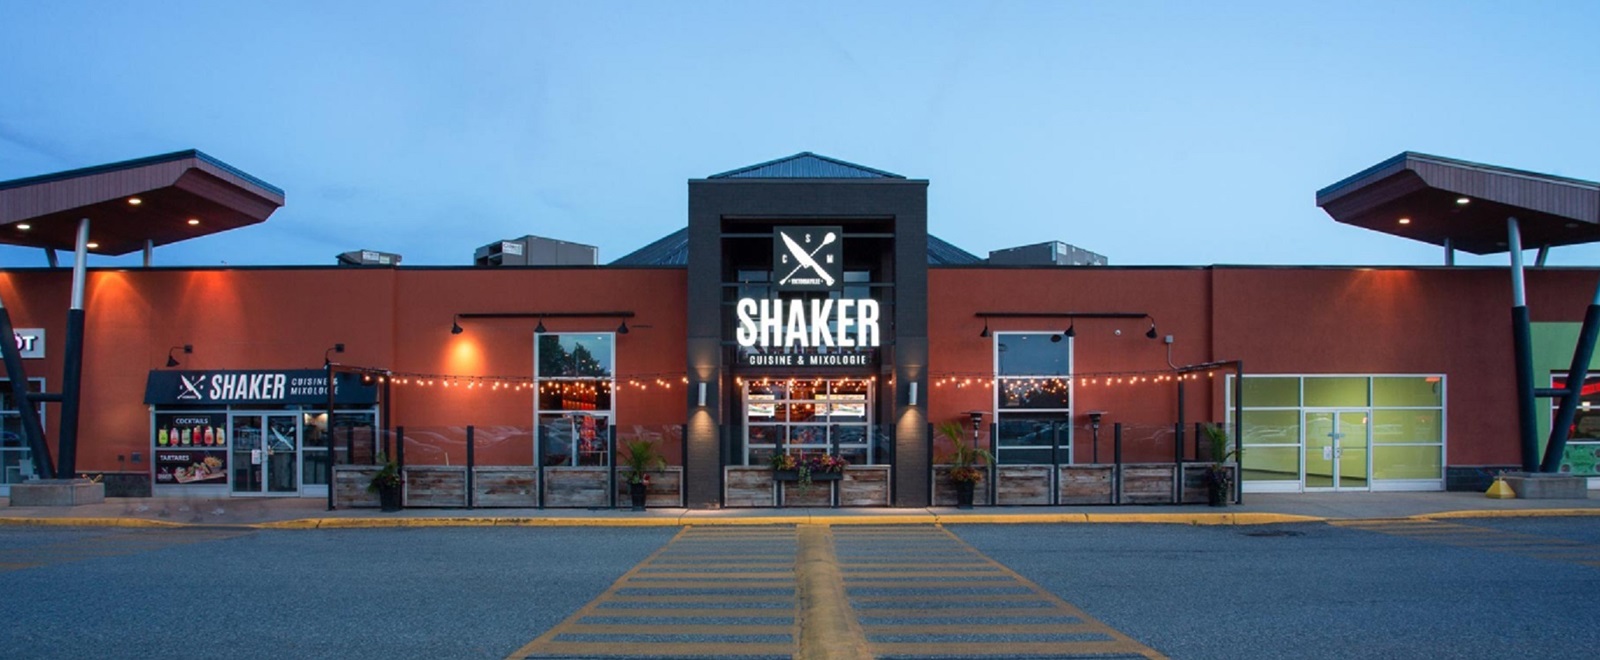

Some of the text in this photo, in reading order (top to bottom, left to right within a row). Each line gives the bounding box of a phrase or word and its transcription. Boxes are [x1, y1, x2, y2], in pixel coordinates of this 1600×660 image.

[805, 233, 811, 243] S
[782, 254, 788, 264] C
[826, 254, 834, 264] M
[736, 297, 880, 347] SHAKER
[749, 355, 867, 365] CUISINE & MIXOLOGIE
[209, 373, 287, 400] SHAKER
[291, 377, 328, 386] CUISINE
[290, 386, 339, 395] MIXOLOE
[175, 417, 209, 425] COCKTAILS
